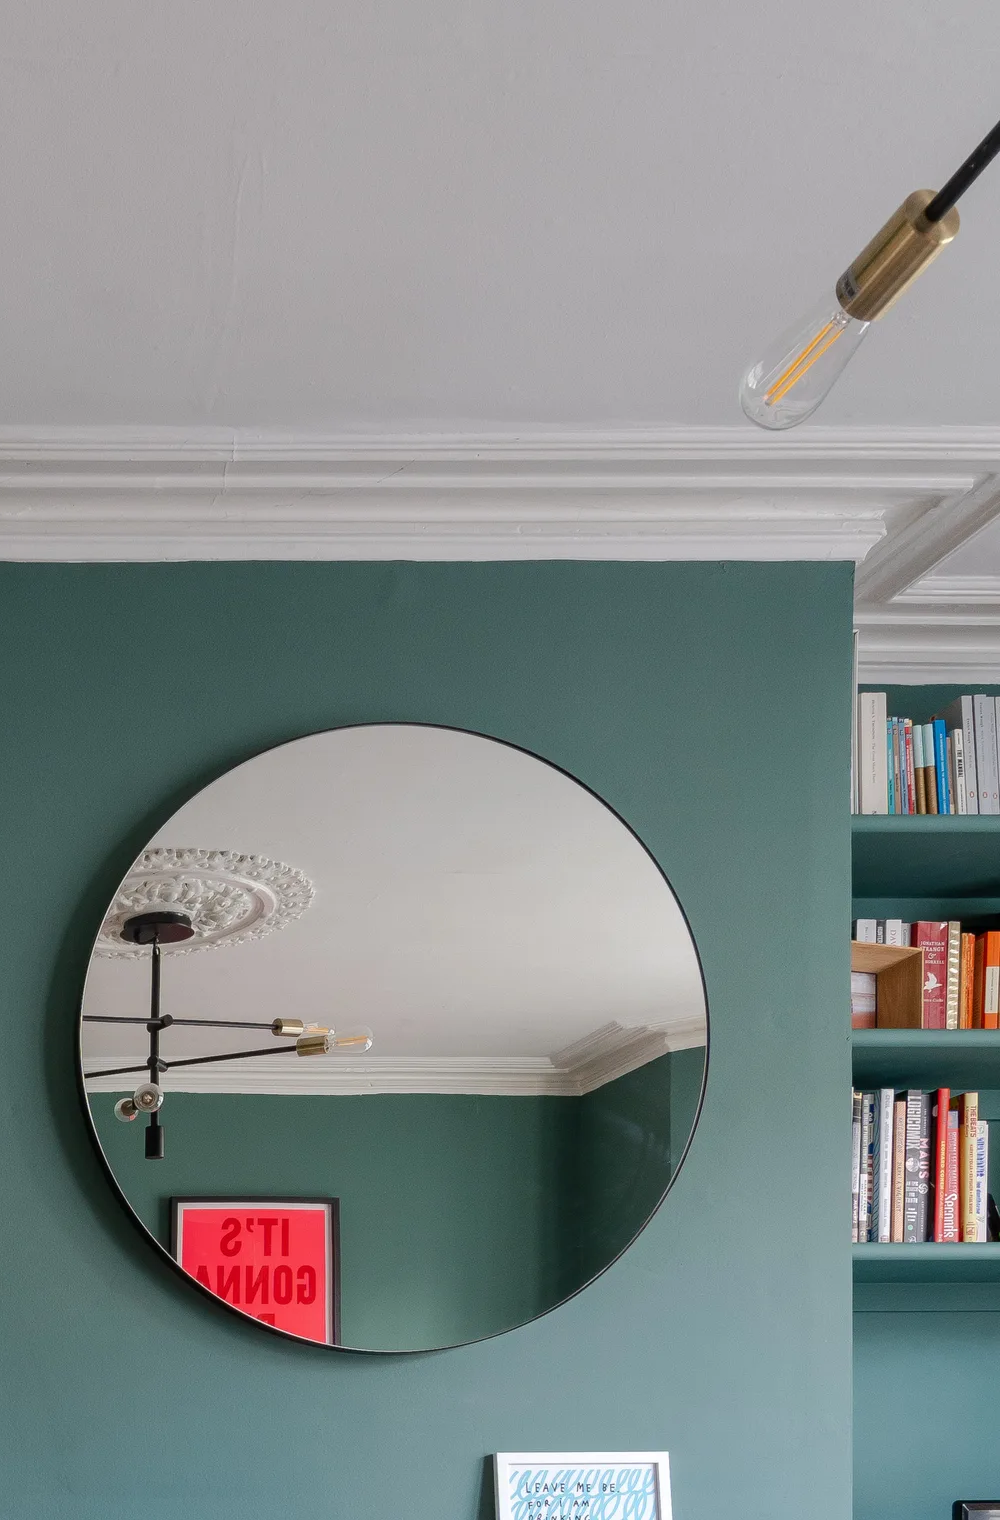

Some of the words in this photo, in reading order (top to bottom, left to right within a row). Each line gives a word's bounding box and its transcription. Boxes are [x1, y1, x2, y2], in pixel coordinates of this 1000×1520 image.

[906, 1095, 921, 1150] LOGICOMIX
[919, 1138, 929, 1179] MAUS
[944, 1193, 957, 1238] Seconds
[525, 1482, 565, 1494] LEAVE
[576, 1482, 591, 1493] ME
[602, 1483, 620, 1493] BE.
[528, 1500, 551, 1509] FOR
[573, 1499, 590, 1508] AM
